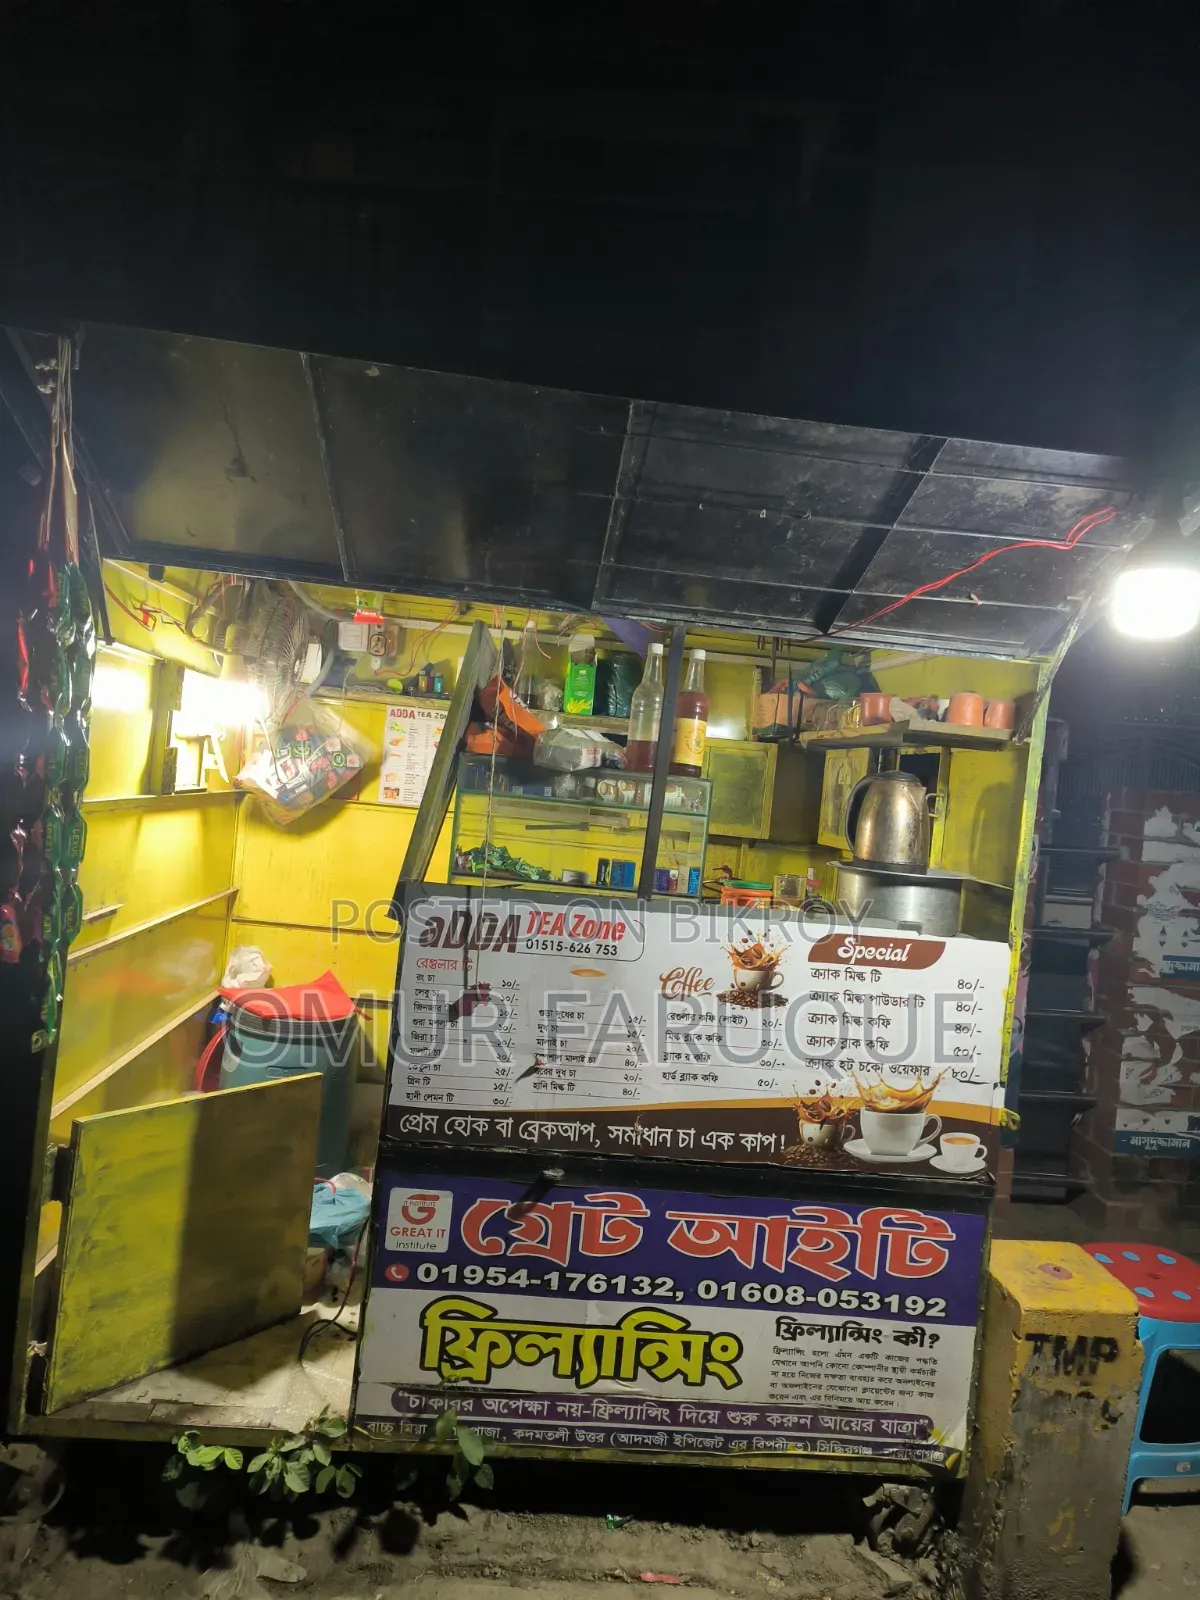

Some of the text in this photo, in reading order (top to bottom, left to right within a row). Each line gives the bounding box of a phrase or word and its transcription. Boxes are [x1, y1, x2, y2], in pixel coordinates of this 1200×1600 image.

[390, 708, 416, 720] ADDA
[526, 911, 626, 941] TEA Zone
[526, 939, 618, 956] 01515-626 753
[837, 936, 913, 964] Special
[417, 957, 459, 971] রেগুলার
[427, 974, 436, 982] চা
[659, 966, 715, 1001] Coffee
[870, 969, 882, 983] টি
[957, 979, 985, 992] ৪০/-
[869, 992, 910, 1008] পাউডার
[913, 994, 926, 1009] টি
[955, 1001, 983, 1015] ৪০/-
[576, 1012, 585, 1020] চা
[867, 1014, 892, 1029] কফি
[954, 1023, 982, 1037] ৪০/-
[559, 1040, 568, 1048] চা
[865, 1037, 891, 1052] কফি
[953, 1045, 982, 1060] ৫০/-
[433, 1064, 441, 1072] চা
[556, 1068, 642, 1083] দুধ চা ২০/-
[839, 1059, 854, 1072] হট
[858, 1061, 884, 1074] চকো
[888, 1064, 932, 1077] ওয়েফার
[951, 1067, 980, 1081] ৮০/-
[422, 1076, 431, 1086] টি
[493, 1082, 513, 1092] ১৫/-
[567, 1081, 576, 1092] টি
[622, 1088, 640, 1097] ৪০/-
[701, 1072, 719, 1083] কফি
[757, 1078, 778, 1089] ৫০/-
[423, 1092, 443, 1102] লেমন
[446, 1092, 454, 1102] টি
[492, 1097, 513, 1107] ৩০/-
[399, 1112, 786, 1153] প্রেম হোক বা ব্রেকআপ, সমাধান চা এক কাপ!
[390, 1226, 447, 1239] GREAT IT
[460, 1191, 956, 1283] গ্রেট আইটি
[396, 1240, 437, 1250] Institute
[416, 1262, 948, 1317] 01954-176132, 01608-053192
[775, 1315, 941, 1349] ফ্রিল্যান্সিং কী?
[419, 1295, 744, 1390] ফ্রিল্যান্সিং
[772, 1359, 798, 1367] যেখানে
[800, 1360, 823, 1369] আপনি
[858, 1352, 880, 1360] একটি
[885, 1354, 910, 1363] কাজের
[481, 1398, 551, 1416] অপেক্ষা
[678, 1404, 721, 1425] দিয়ে
[726, 1409, 761, 1427] শুরু
[765, 1412, 814, 1429] করুন
[818, 1415, 876, 1433] আয়ের
[367, 1420, 396, 1436] বাচ্চু
[400, 1420, 428, 1435] মিয়া
[512, 1427, 570, 1443] কদমতলী
[574, 1429, 606, 1444] উত্তর
[609, 1430, 670, 1447] (আদমজী
[672, 1432, 725, 1450] ইপিজেট
[727, 1438, 748, 1450] এর
